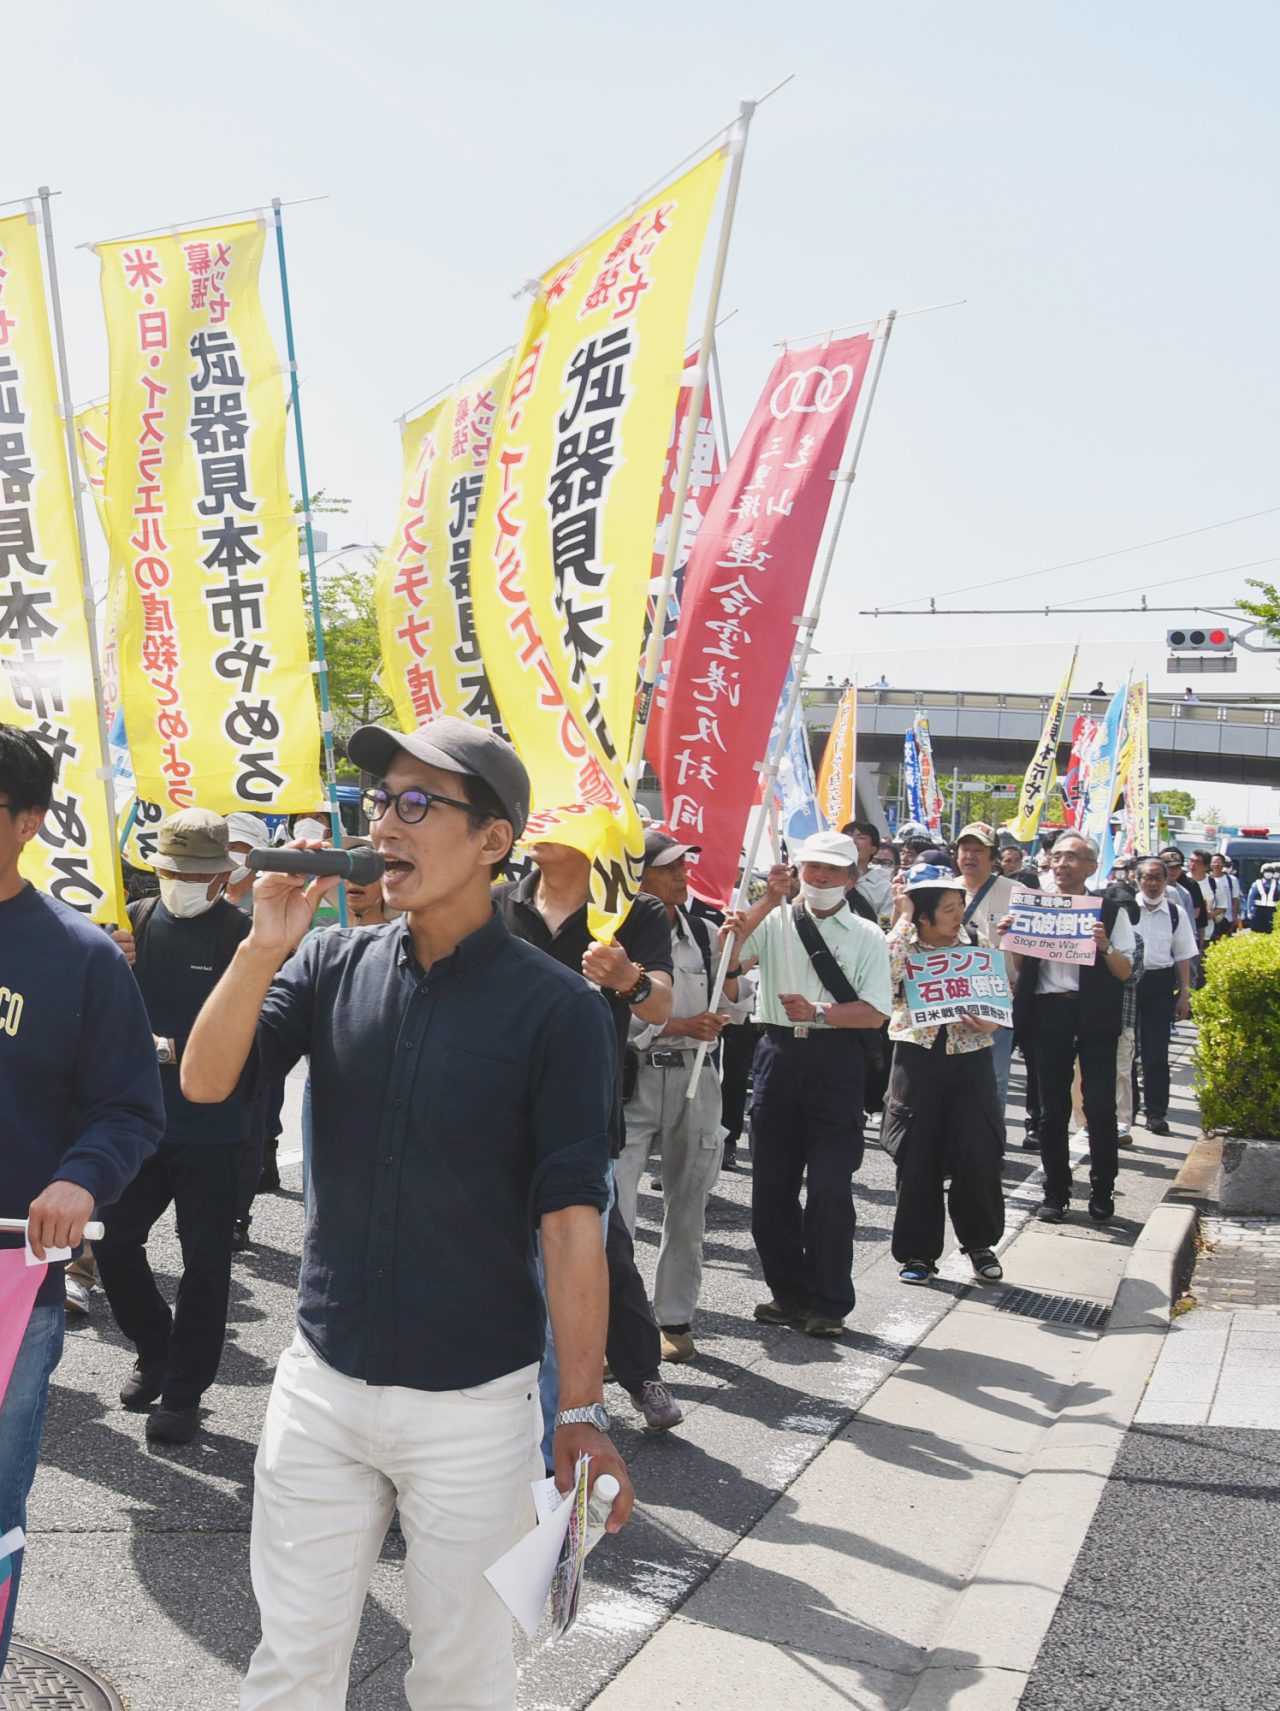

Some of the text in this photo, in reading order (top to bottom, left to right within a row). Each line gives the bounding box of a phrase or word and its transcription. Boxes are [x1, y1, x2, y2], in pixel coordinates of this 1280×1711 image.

[1013, 935, 1079, 950] Stop the War
[1049, 949, 1095, 960] on China!
